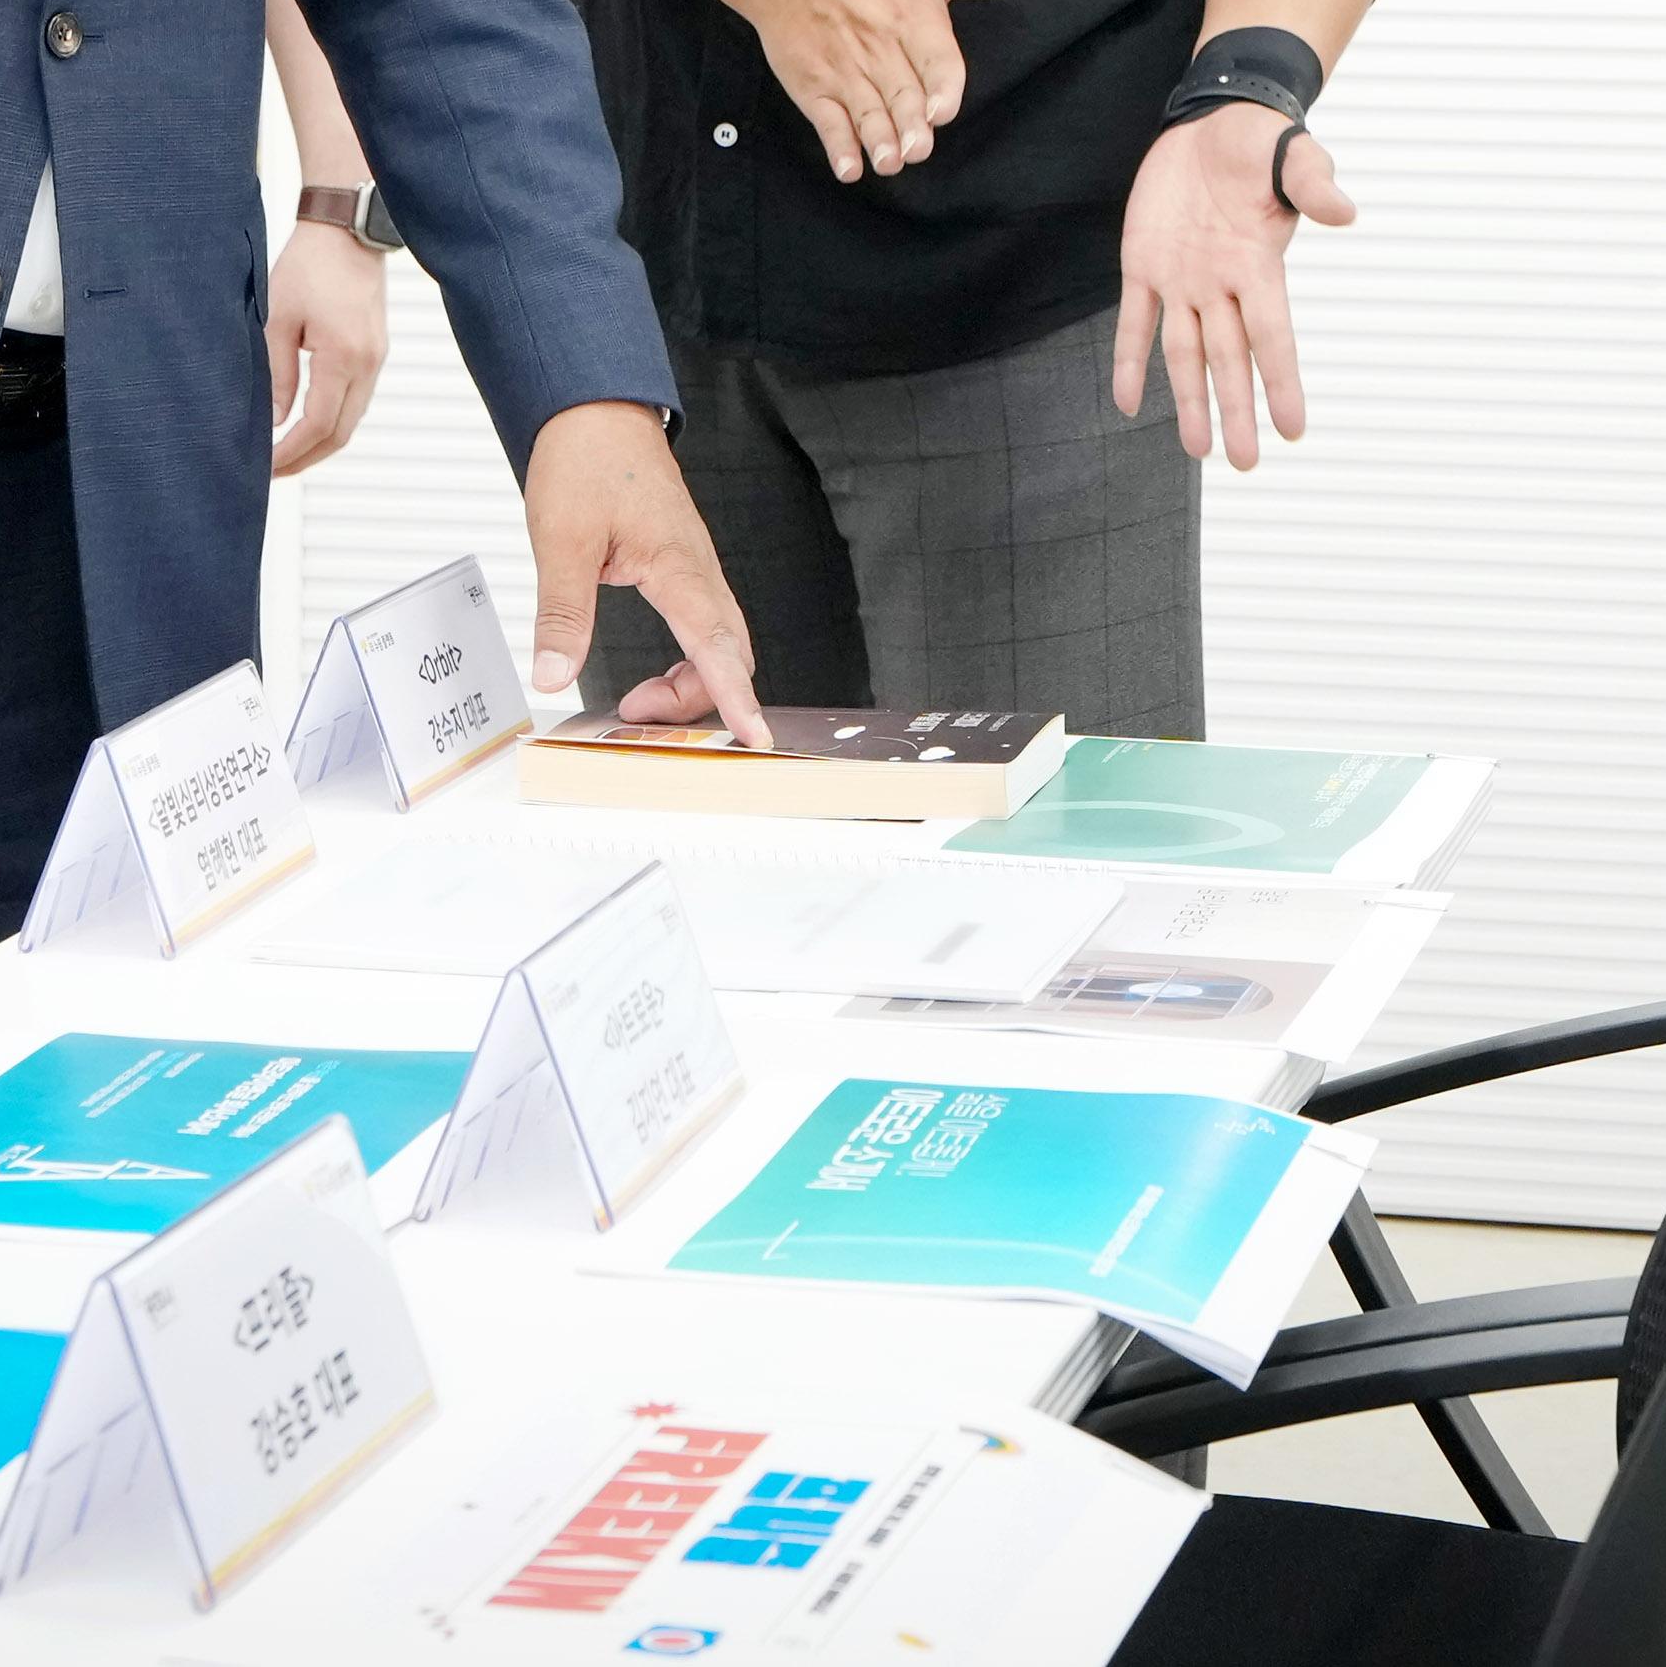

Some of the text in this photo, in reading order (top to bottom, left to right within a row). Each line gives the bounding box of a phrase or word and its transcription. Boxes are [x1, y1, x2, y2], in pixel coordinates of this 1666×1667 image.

[418, 642, 463, 685] <Orbit>
[428, 691, 491, 754] 강수지 대표
[148, 742, 271, 839] <달빛심리상담연구소>
[237, 817, 268, 862] 대표
[604, 979, 665, 1054] <아트로운>
[664, 1050, 697, 1104] 대표
[233, 1266, 315, 1353] <프리즐>
[250, 1348, 360, 1476] 강승호 대표
[485, 1425, 771, 1613] FREEKIN
